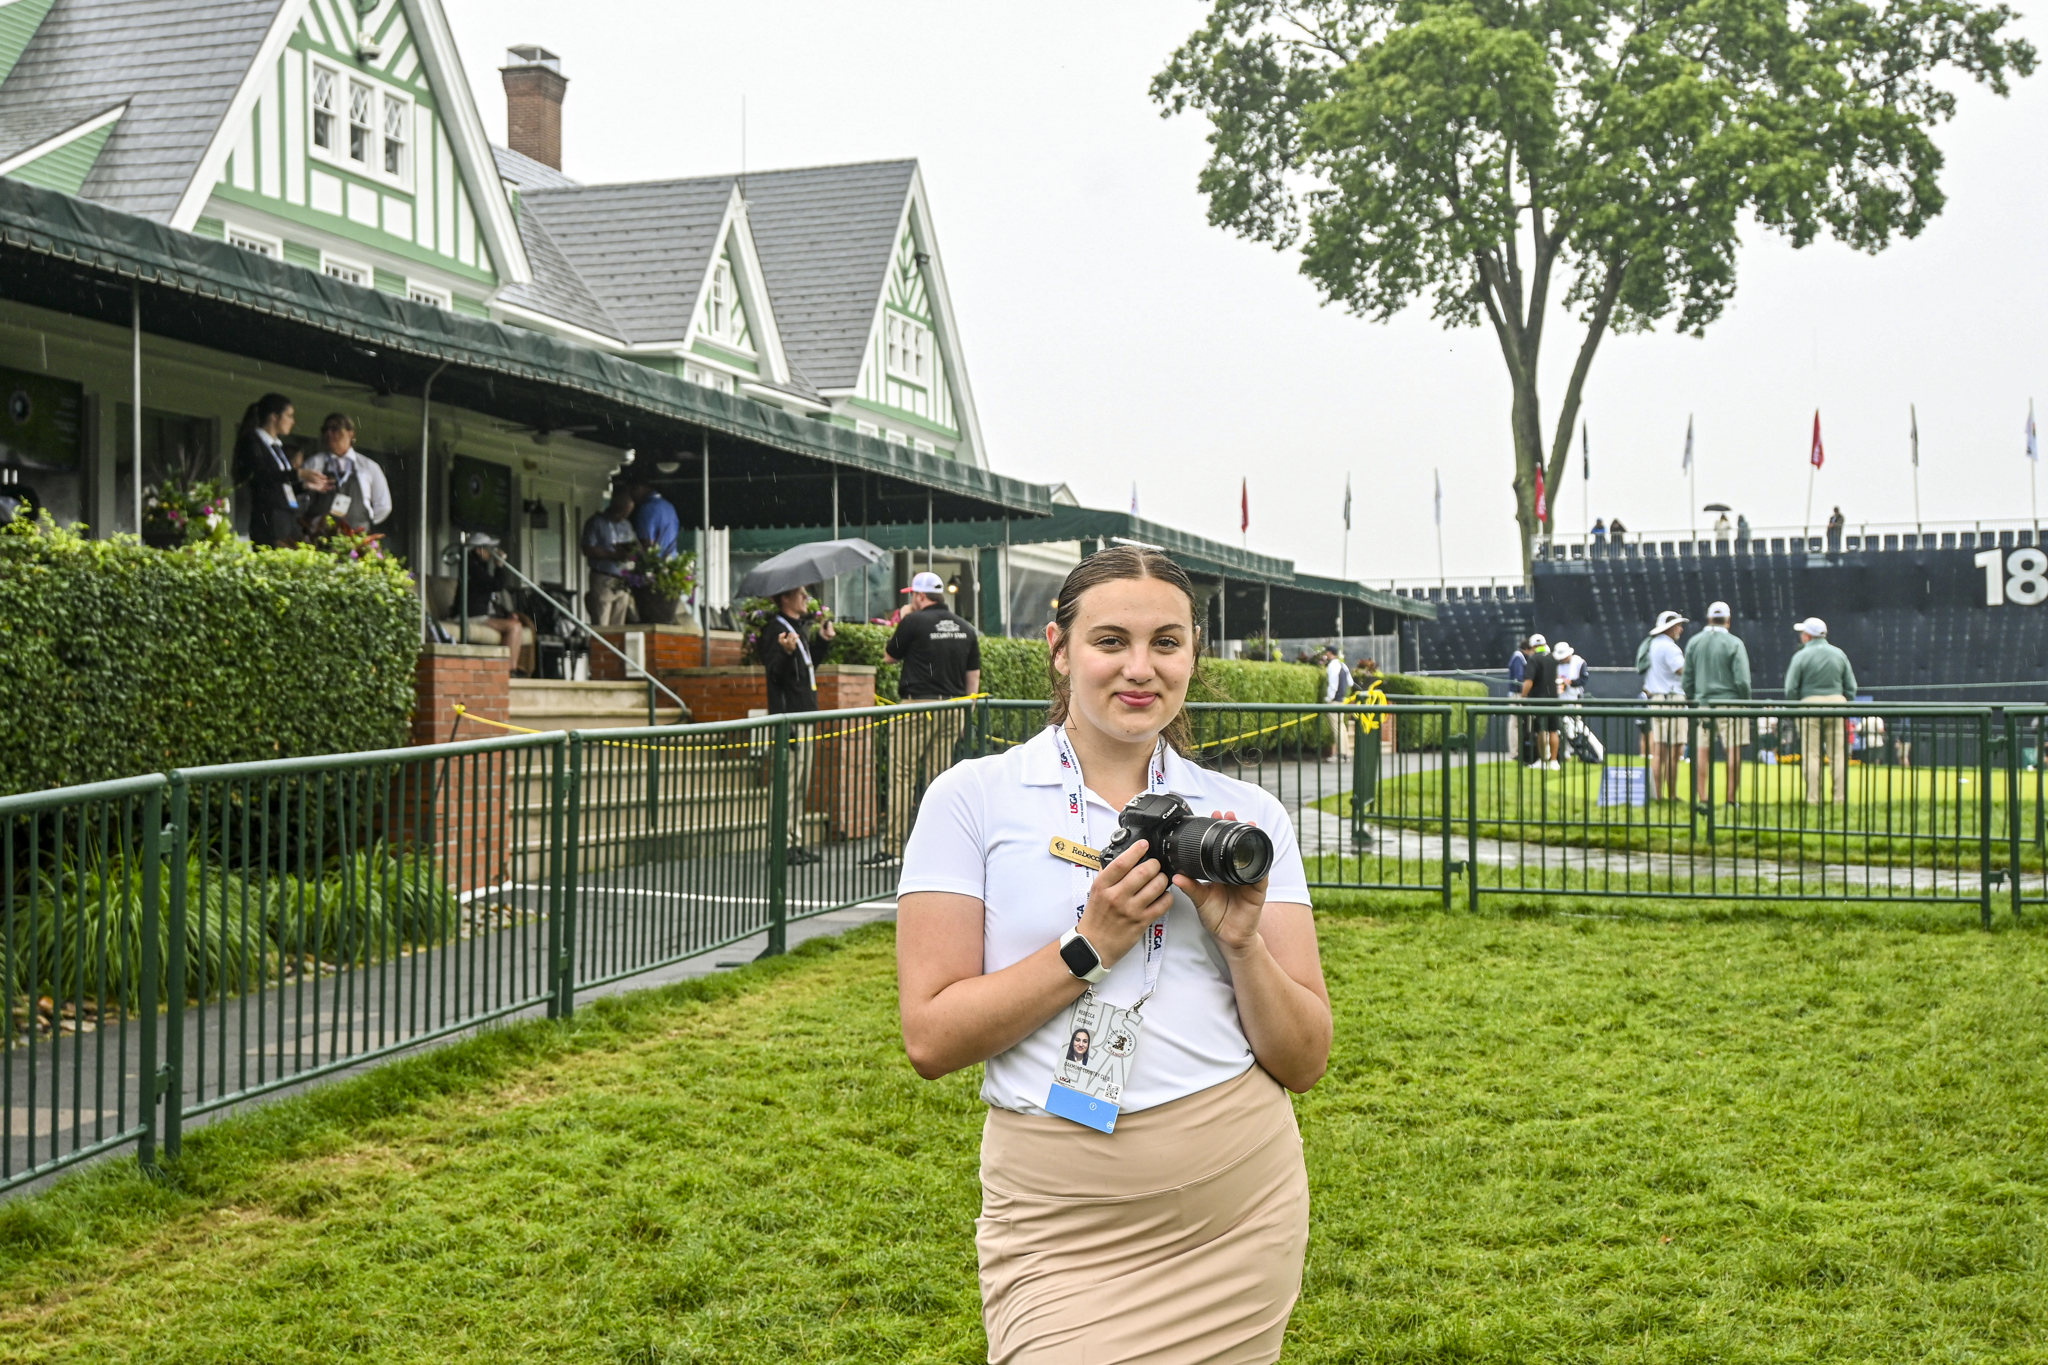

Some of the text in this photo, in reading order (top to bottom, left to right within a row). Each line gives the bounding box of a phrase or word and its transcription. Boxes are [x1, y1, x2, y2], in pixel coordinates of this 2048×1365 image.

[1975, 548, 2048, 606] 18
[1069, 793, 1078, 813] USGA
[1162, 803, 1178, 820] Canon
[1071, 846, 1101, 863] Rebecc
[1152, 923, 1163, 950] USGA
